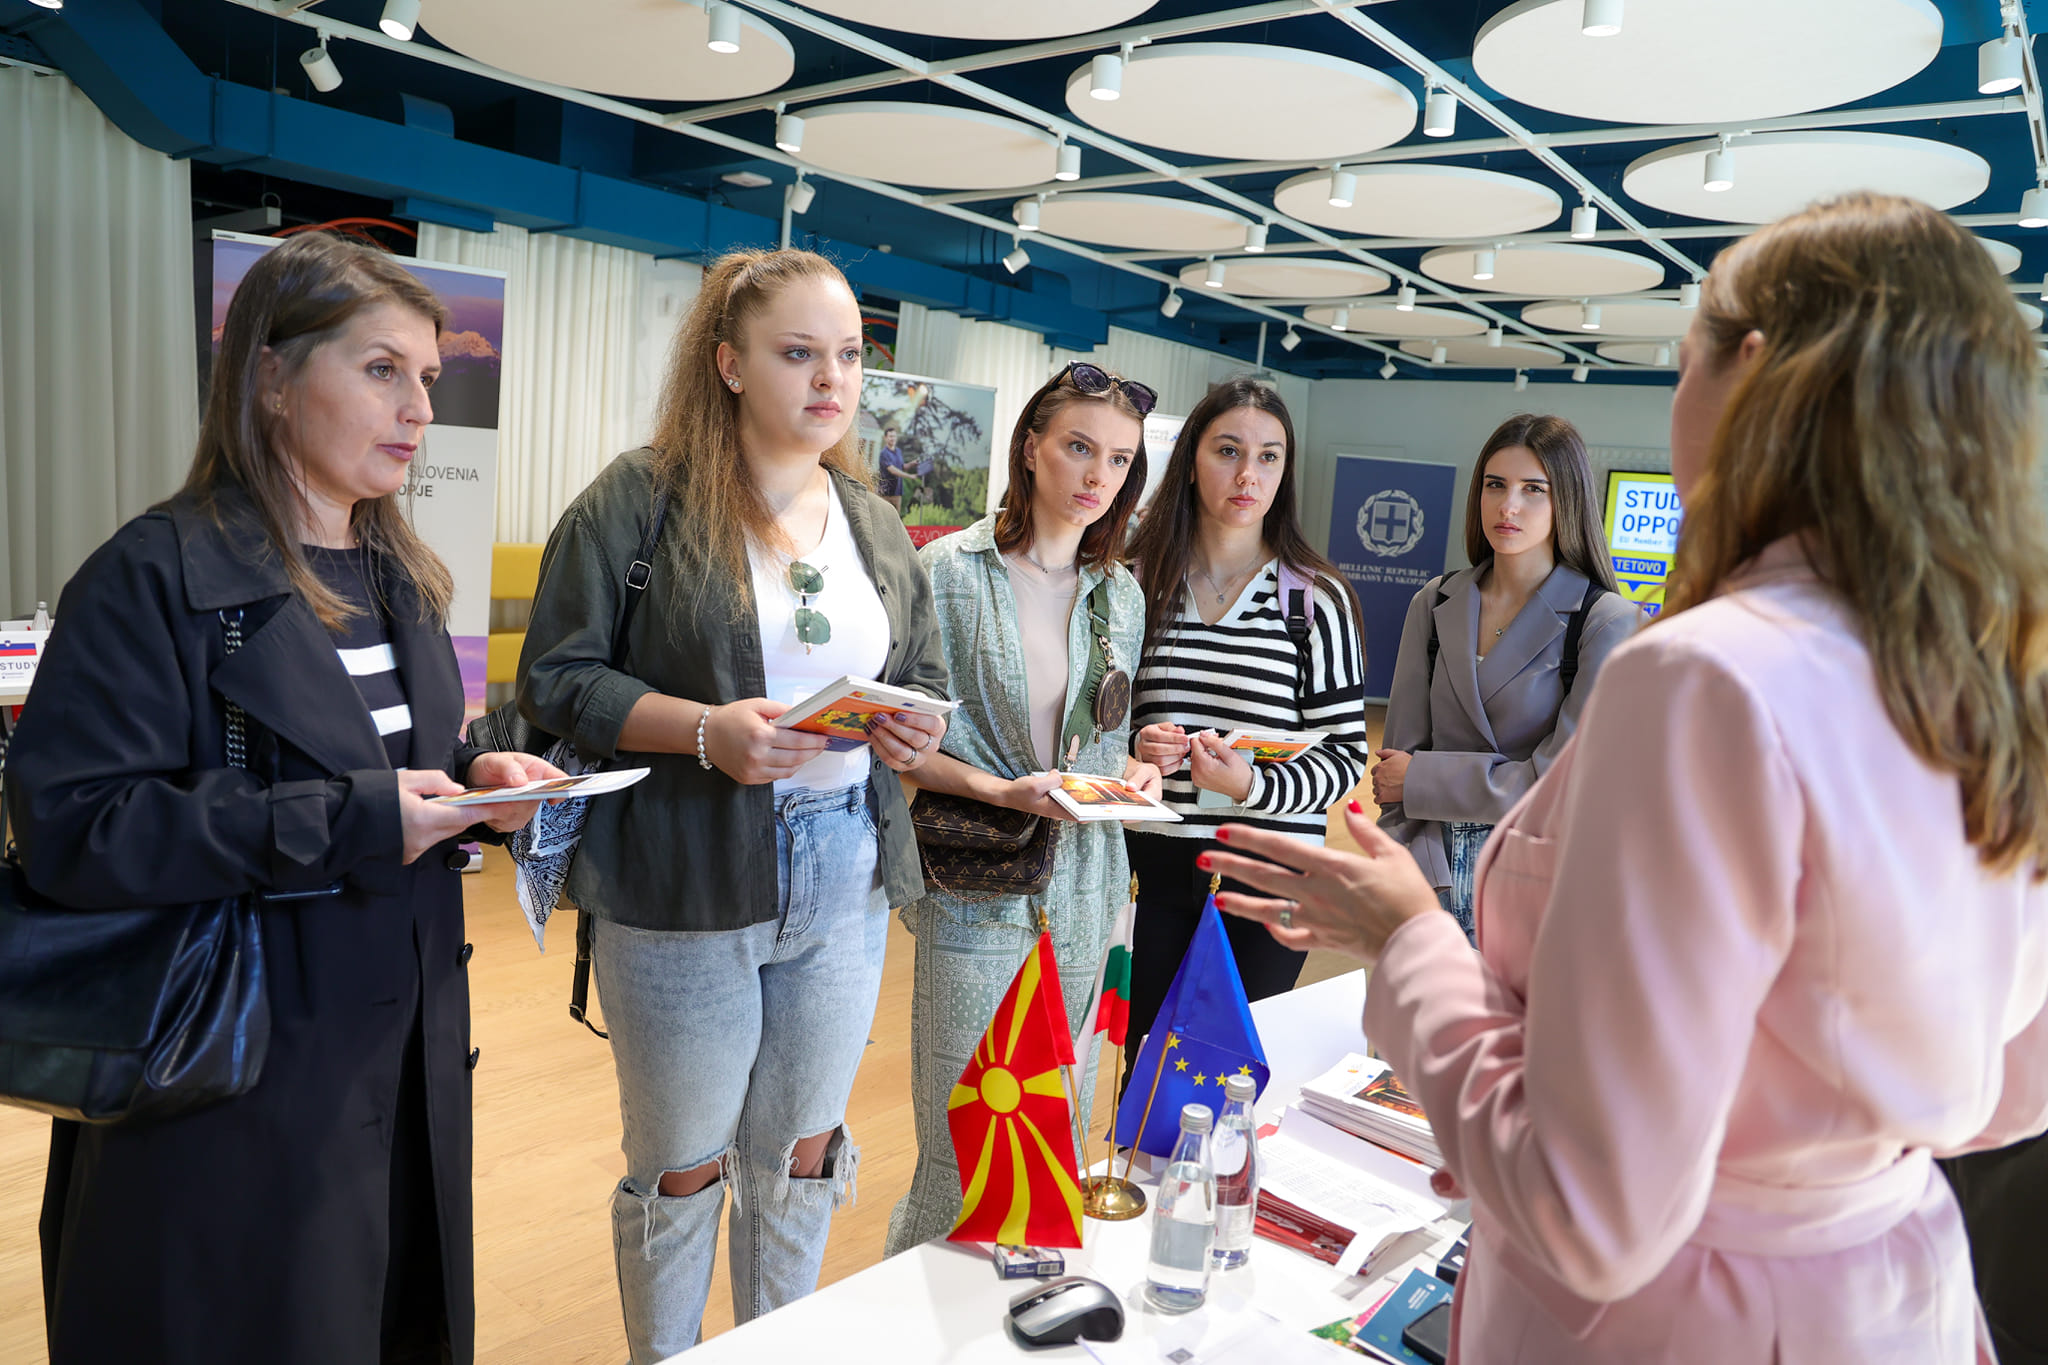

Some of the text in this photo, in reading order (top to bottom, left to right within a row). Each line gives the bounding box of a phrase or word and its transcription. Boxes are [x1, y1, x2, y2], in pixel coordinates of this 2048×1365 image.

[408, 464, 479, 481] SLOVENIA
[1338, 562, 1430, 577] HELLENIC REPUBLIC
[1615, 558, 1662, 574] TETOVO
[0, 661, 38, 671] STUDY
